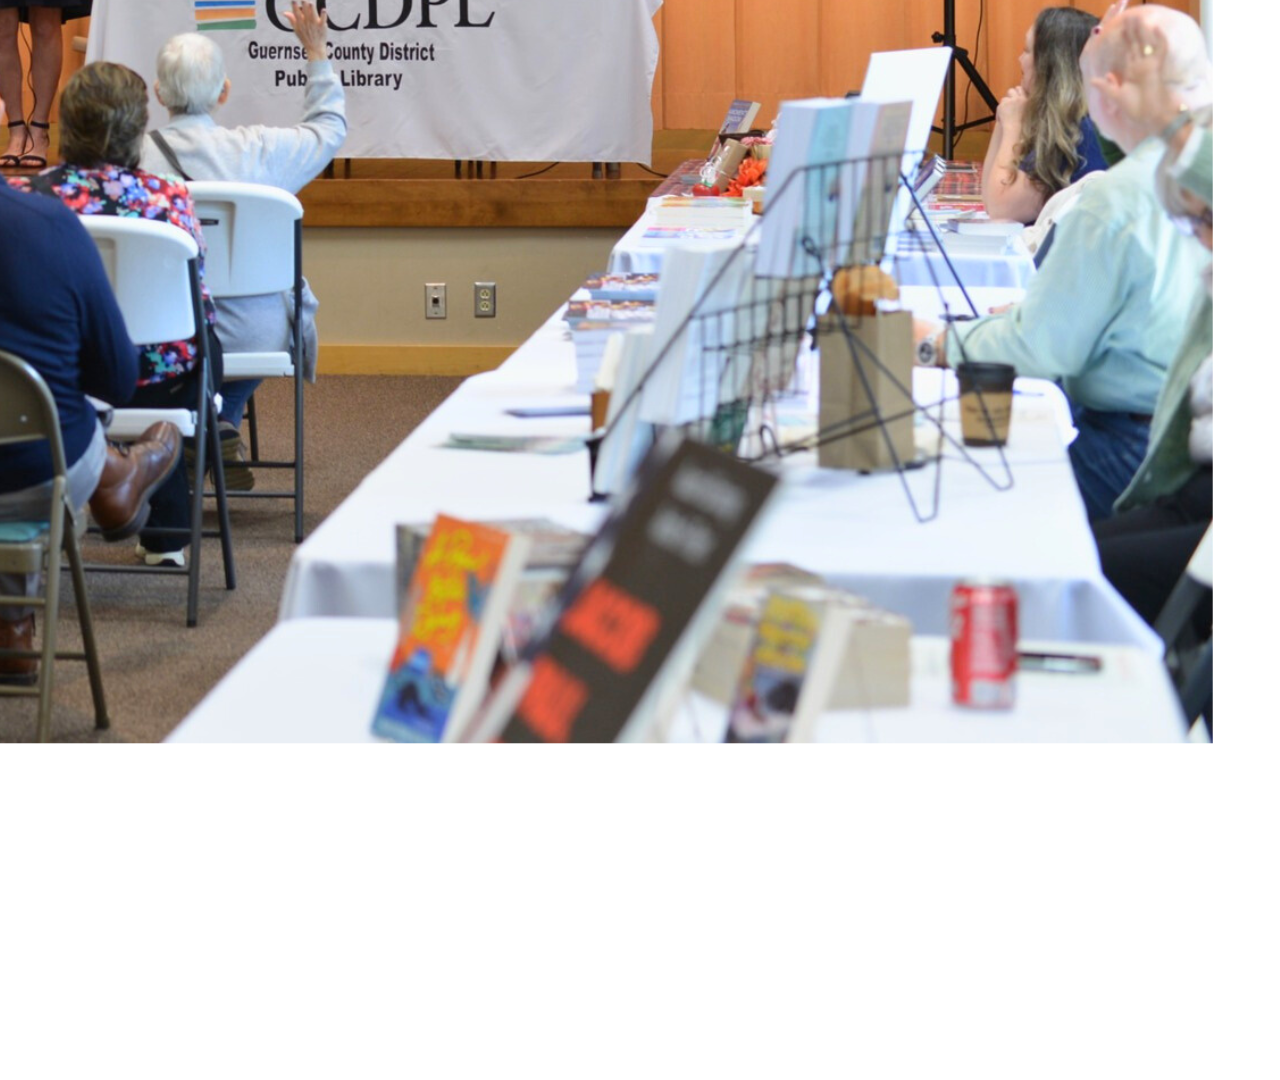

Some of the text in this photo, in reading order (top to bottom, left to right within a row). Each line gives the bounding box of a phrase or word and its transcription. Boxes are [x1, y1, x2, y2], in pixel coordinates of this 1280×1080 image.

[248, 41, 435, 65] Guernse County District
[274, 70, 403, 90] Pub Library
